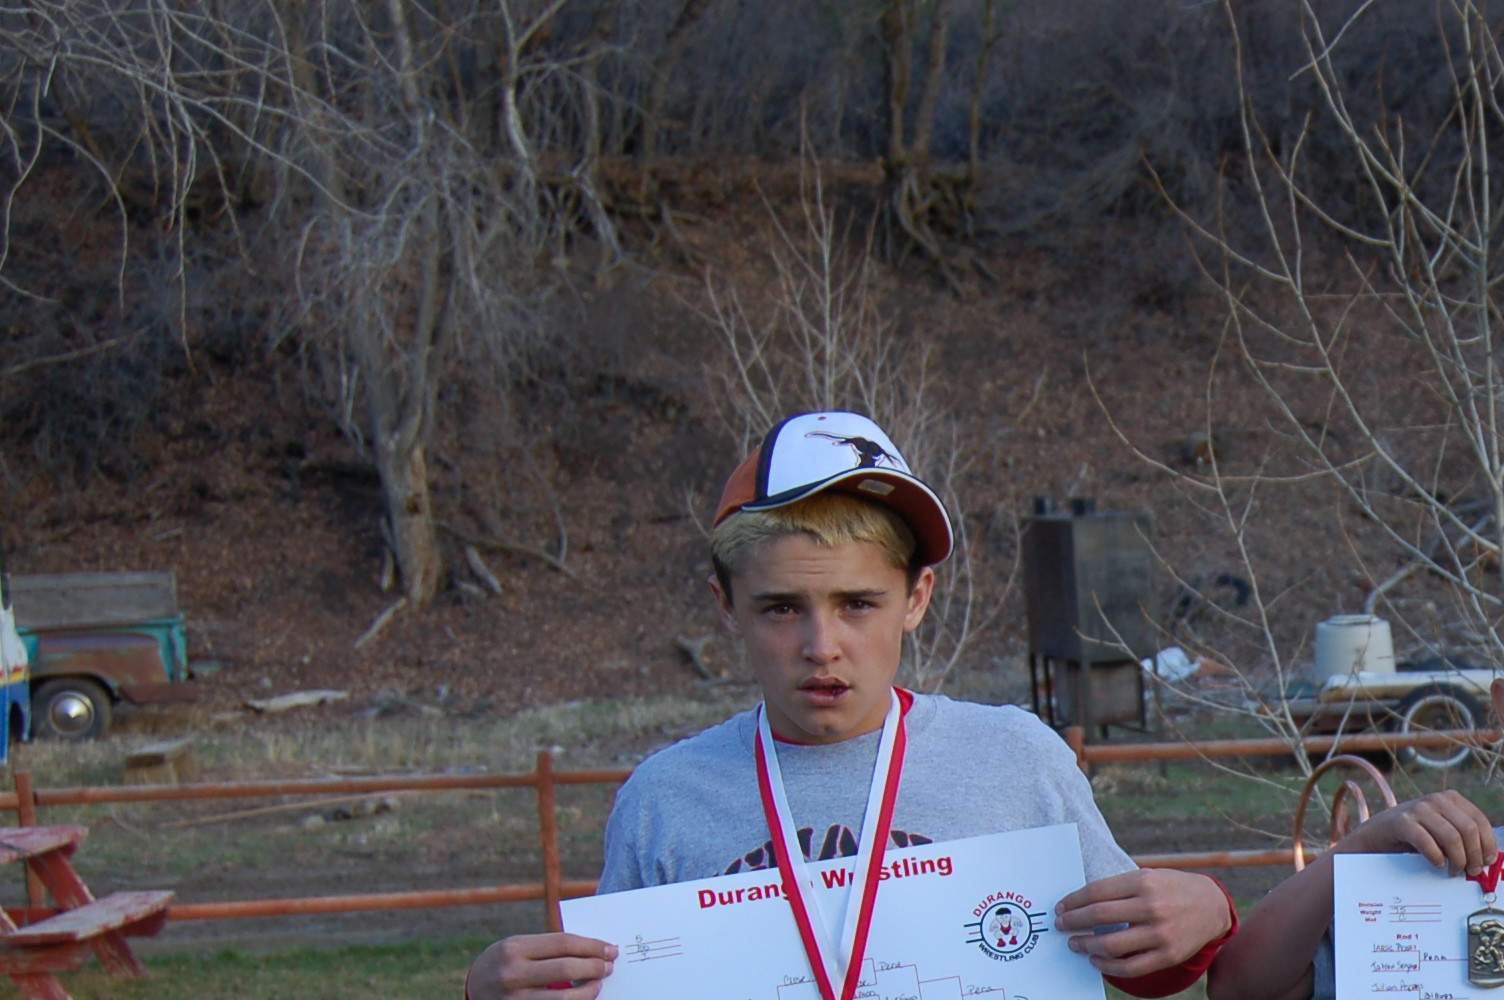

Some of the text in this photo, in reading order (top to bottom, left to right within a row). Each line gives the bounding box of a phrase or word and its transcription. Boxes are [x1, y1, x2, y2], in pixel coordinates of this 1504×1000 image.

[698, 856, 954, 909] Durang Wrstling
[973, 891, 1032, 917] DURANGO
[1024, 934, 1039, 954] CLUB
